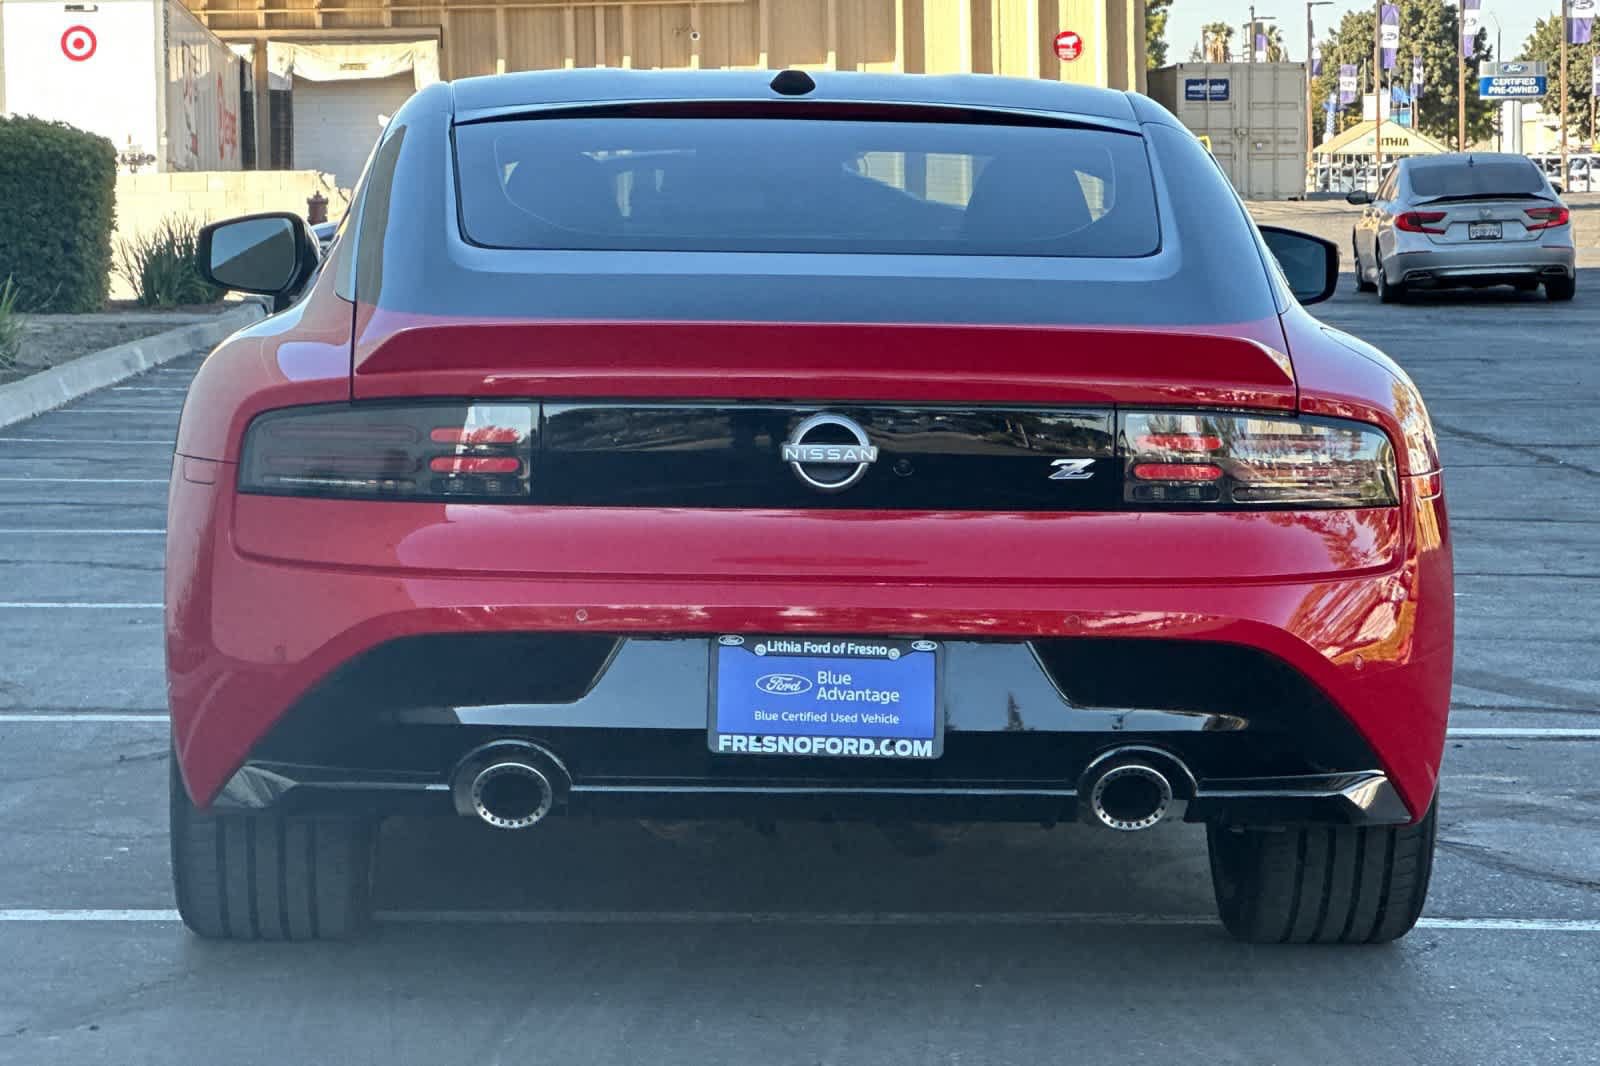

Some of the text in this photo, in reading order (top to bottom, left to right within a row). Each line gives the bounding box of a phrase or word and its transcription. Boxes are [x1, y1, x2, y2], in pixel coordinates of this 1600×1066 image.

[1492, 77, 1536, 86] CERTIFIED
[1488, 86, 1539, 95] PRE-OWNED
[1376, 137, 1409, 147] ITHIA
[783, 447, 876, 461] NISSAN
[1049, 458, 1096, 480] Z
[767, 640, 888, 656] Lithia Ford of Fresno
[765, 676, 802, 692] Ford
[817, 671, 852, 685] Blue
[816, 687, 900, 704] Advantage
[754, 711, 900, 725] Blue Certified Used Vehicle
[718, 734, 933, 757] FRESNOFORD.COM
